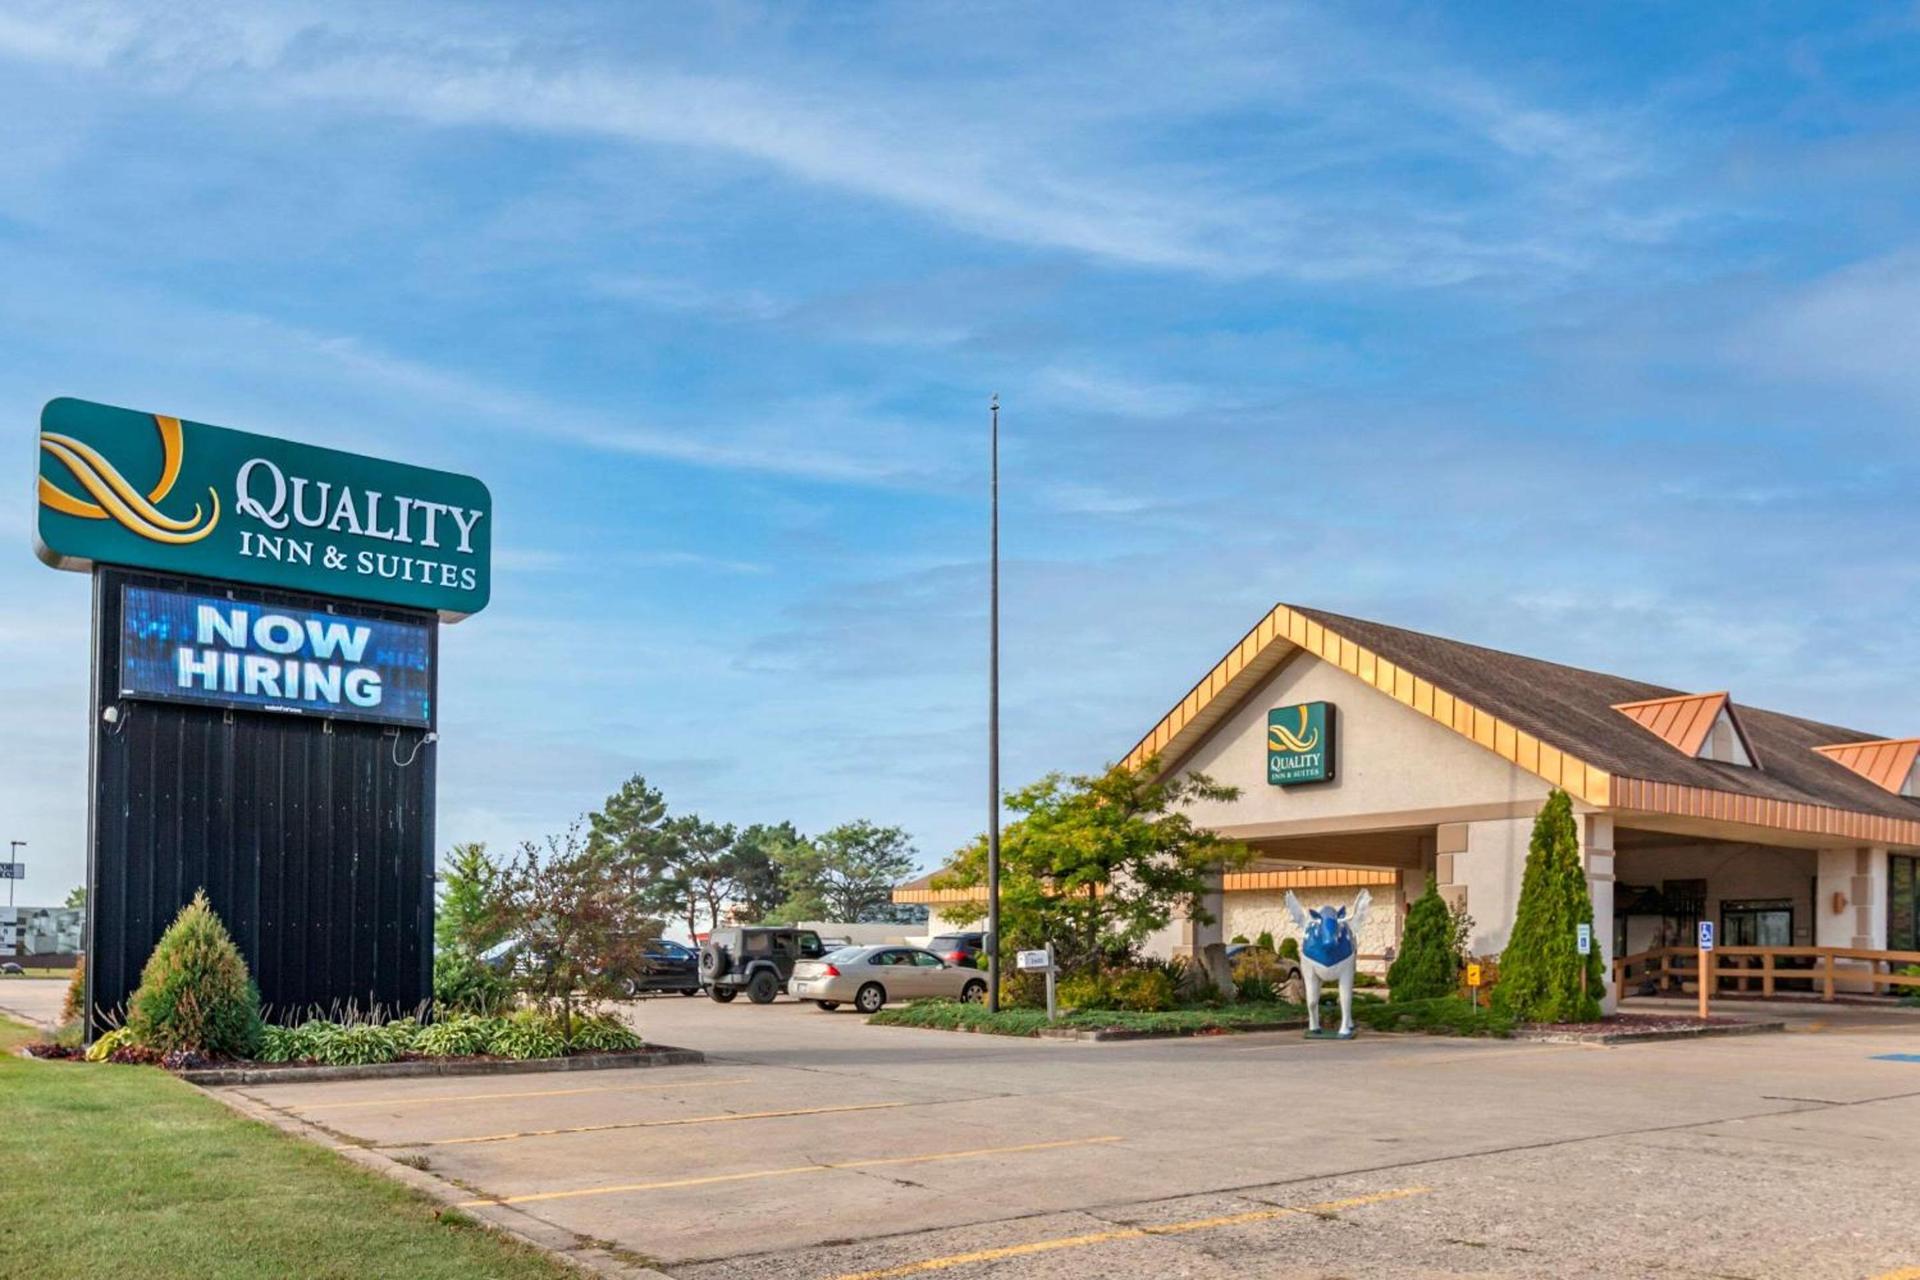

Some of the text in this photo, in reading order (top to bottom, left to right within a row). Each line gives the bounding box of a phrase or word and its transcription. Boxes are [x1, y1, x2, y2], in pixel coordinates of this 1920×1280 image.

[236, 458, 483, 554] QUALITY
[239, 530, 477, 591] INN & SUITES
[197, 604, 372, 662] NOW
[177, 647, 382, 707] HIRING
[1271, 753, 1320, 772] QUALITY
